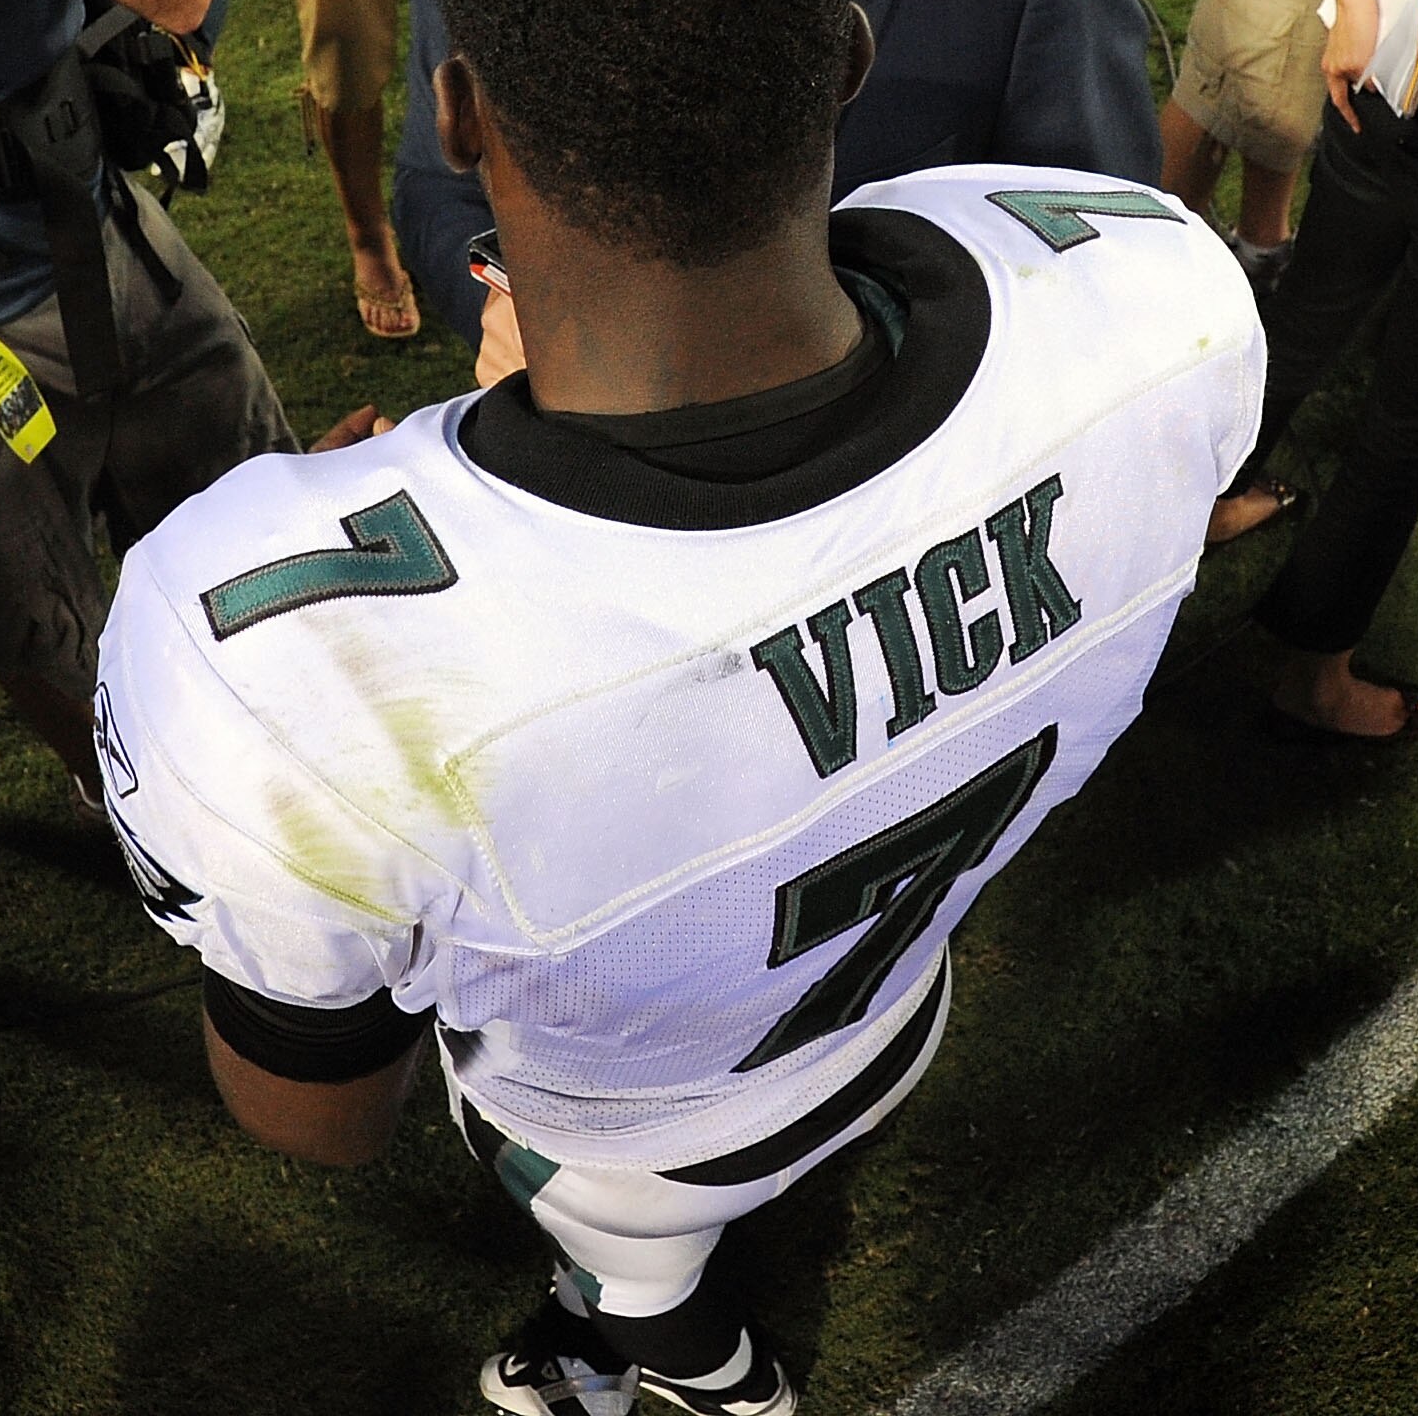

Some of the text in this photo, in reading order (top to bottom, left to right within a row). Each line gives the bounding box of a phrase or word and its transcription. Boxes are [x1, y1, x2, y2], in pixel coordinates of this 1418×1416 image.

[198, 489, 460, 642] 7
[750, 472, 1084, 779] VICK
[729, 722, 1060, 1075] 7
